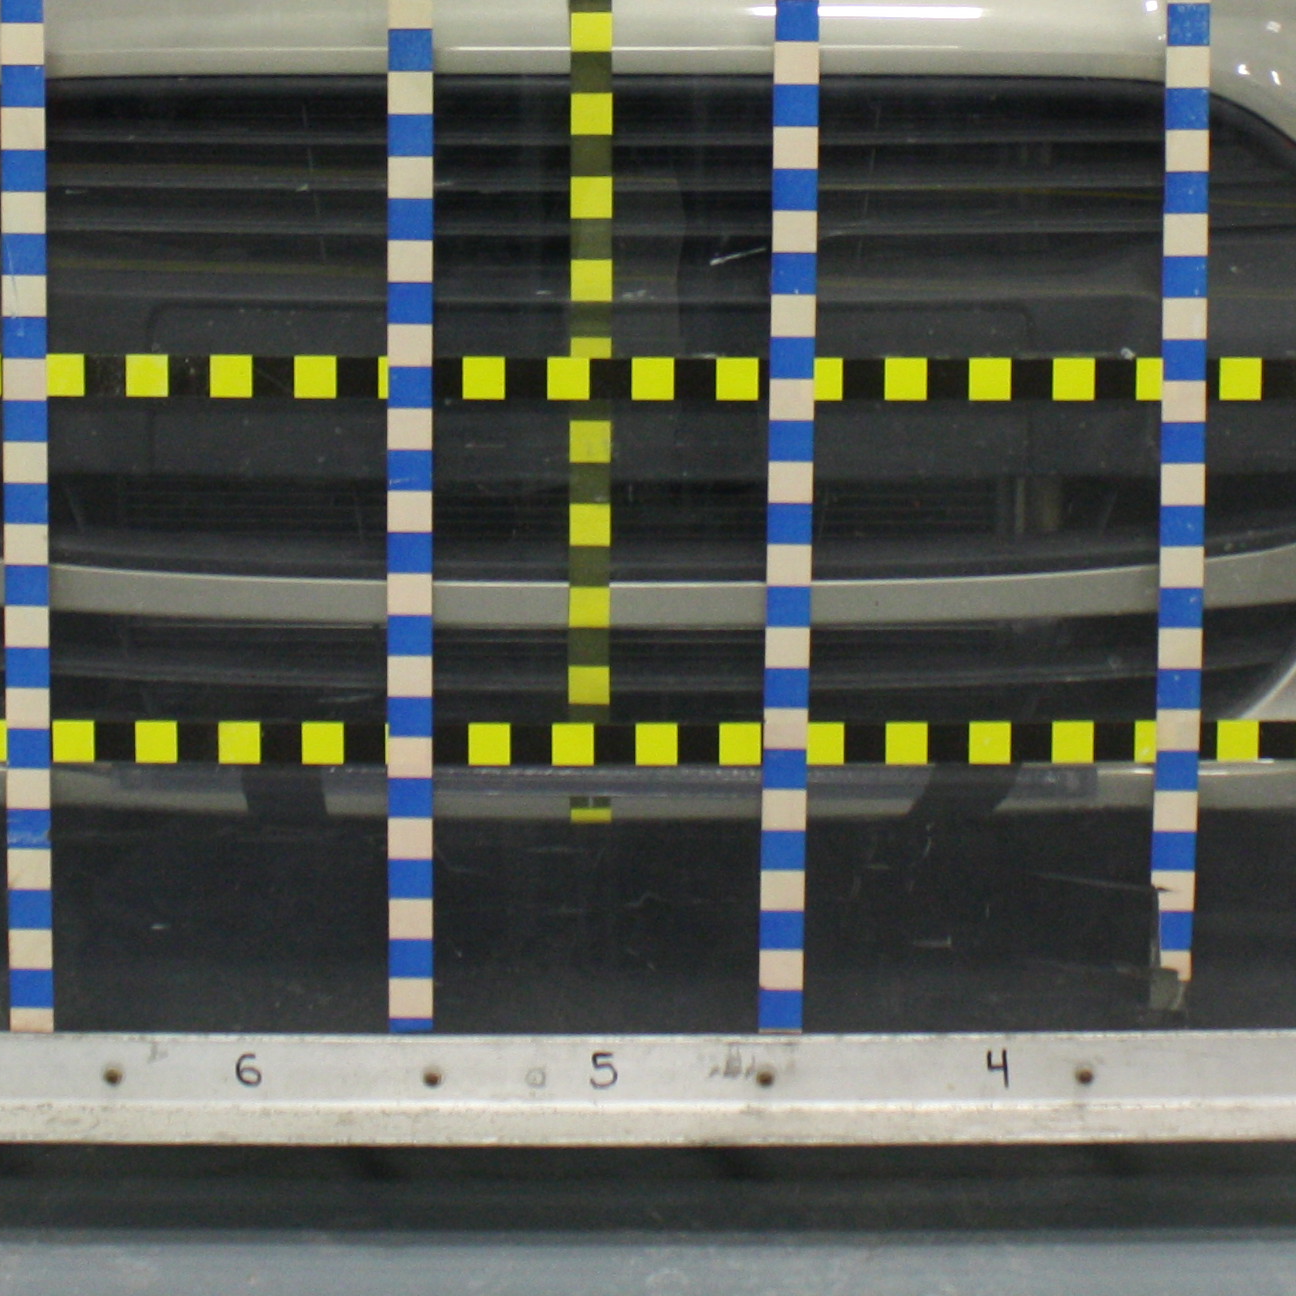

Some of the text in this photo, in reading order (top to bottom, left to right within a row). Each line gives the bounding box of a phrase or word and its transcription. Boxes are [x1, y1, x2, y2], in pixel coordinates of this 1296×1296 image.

[235, 1052, 262, 1087] 6
[590, 1052, 618, 1089] 5
[986, 1048, 1009, 1089] 4
